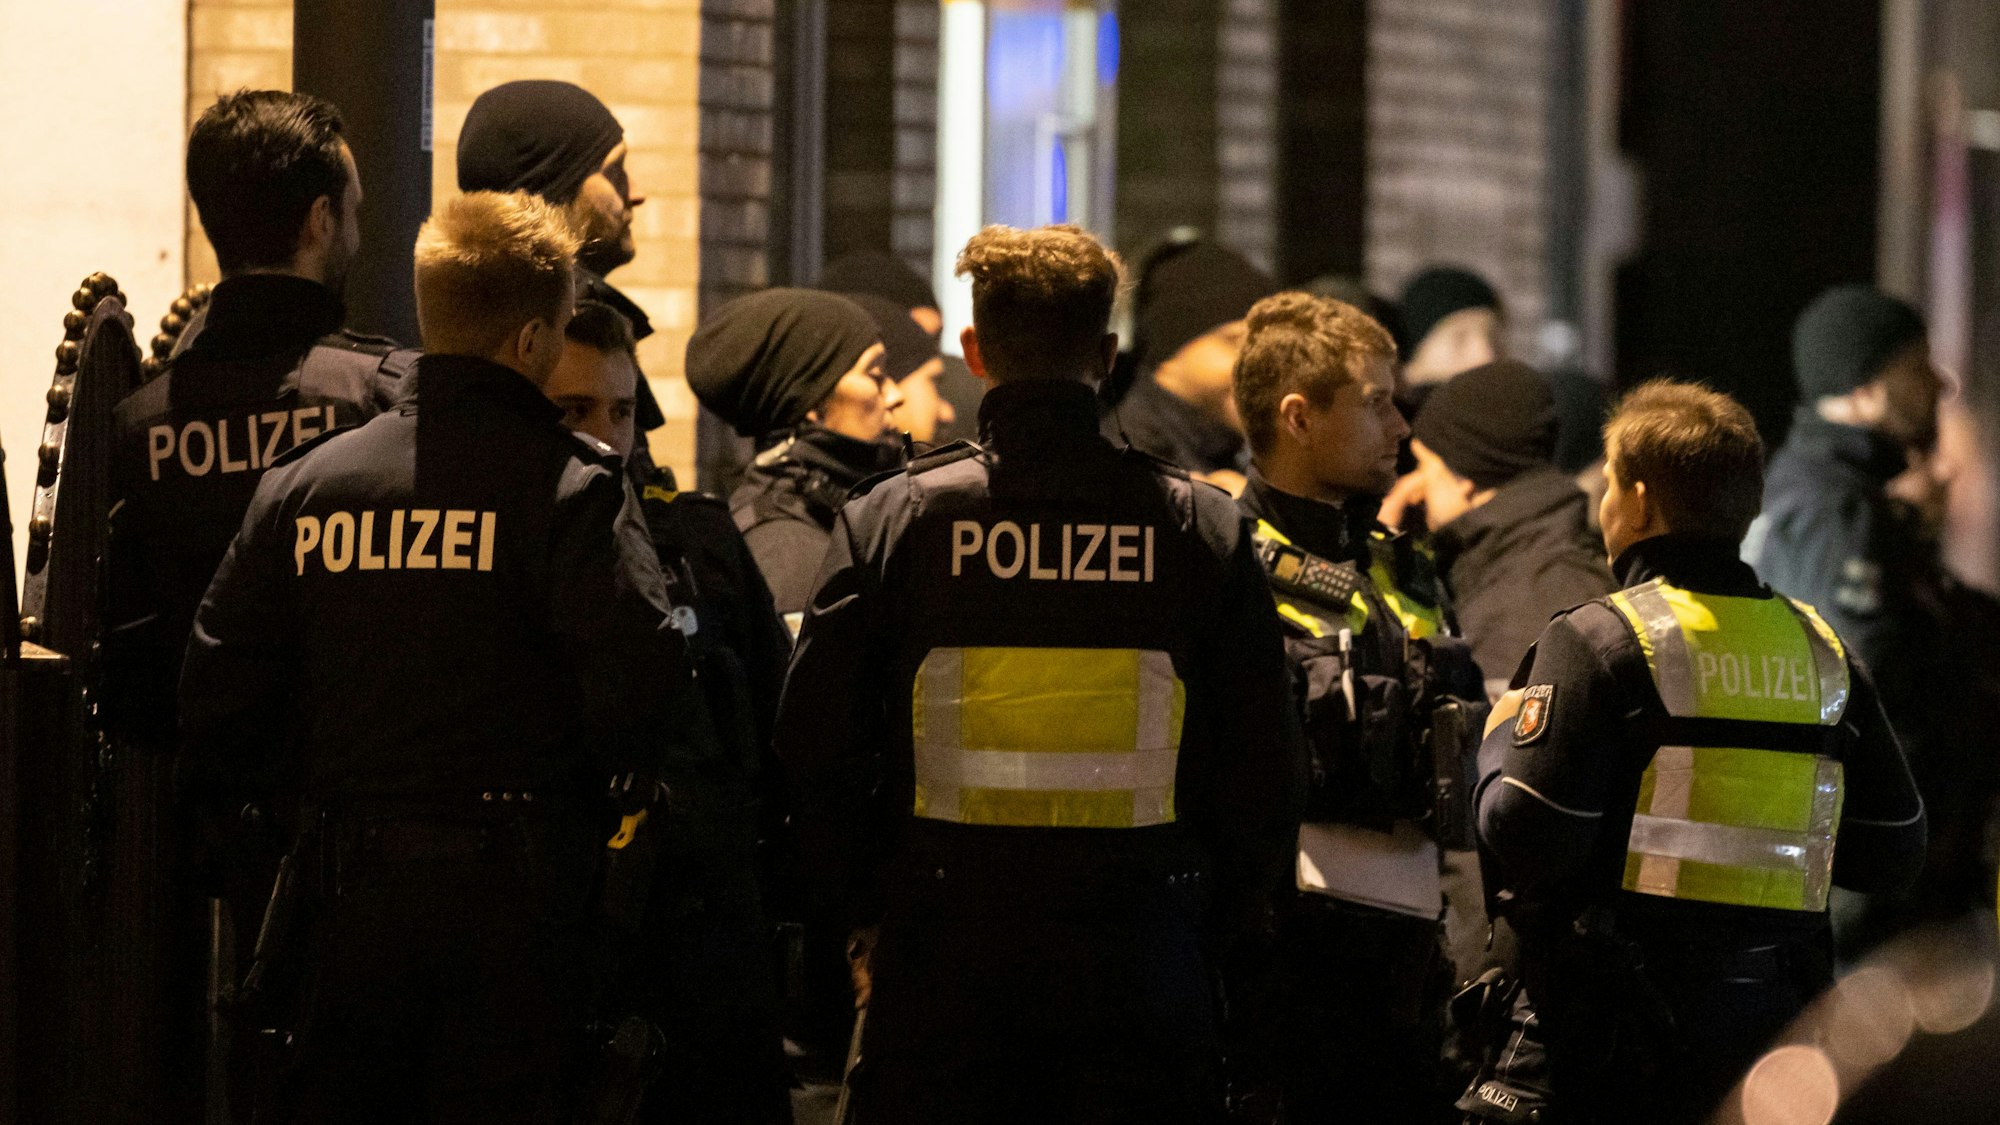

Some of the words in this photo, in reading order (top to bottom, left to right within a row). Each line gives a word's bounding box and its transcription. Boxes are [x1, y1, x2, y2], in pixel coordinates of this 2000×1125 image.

[294, 509, 497, 577] POLIZEI
[951, 520, 1155, 583] POLIZEI
[1697, 652, 1816, 702] POLIZEI
[1474, 1083, 1519, 1112] POLIZEI
